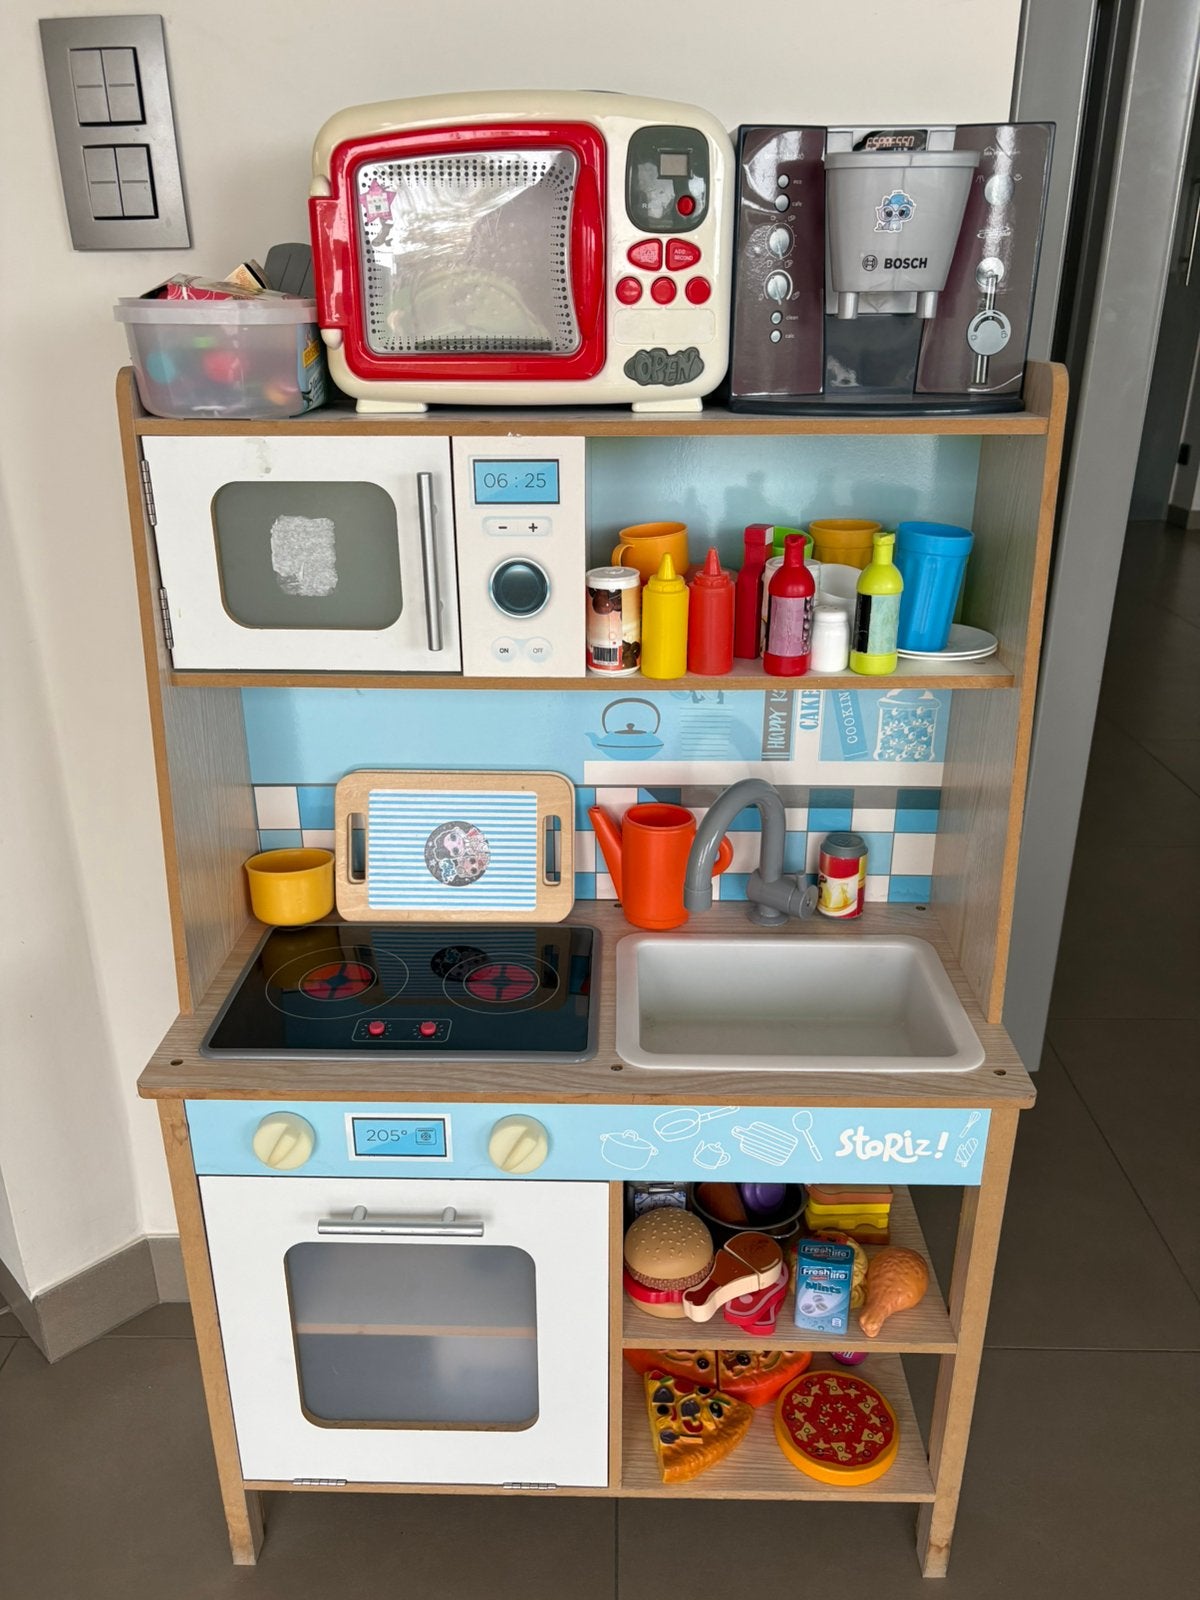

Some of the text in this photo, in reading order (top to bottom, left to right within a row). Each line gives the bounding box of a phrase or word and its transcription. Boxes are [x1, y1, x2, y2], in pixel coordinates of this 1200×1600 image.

[884, 257, 928, 269] BOSCH
[634, 350, 698, 383] OPEN
[799, 690, 820, 730] CAKE
[838, 690, 859, 745] COOKIN
[803, 1267, 830, 1276] Fresh
[830, 1271, 846, 1280] life
[805, 1280, 842, 1294] Mints
